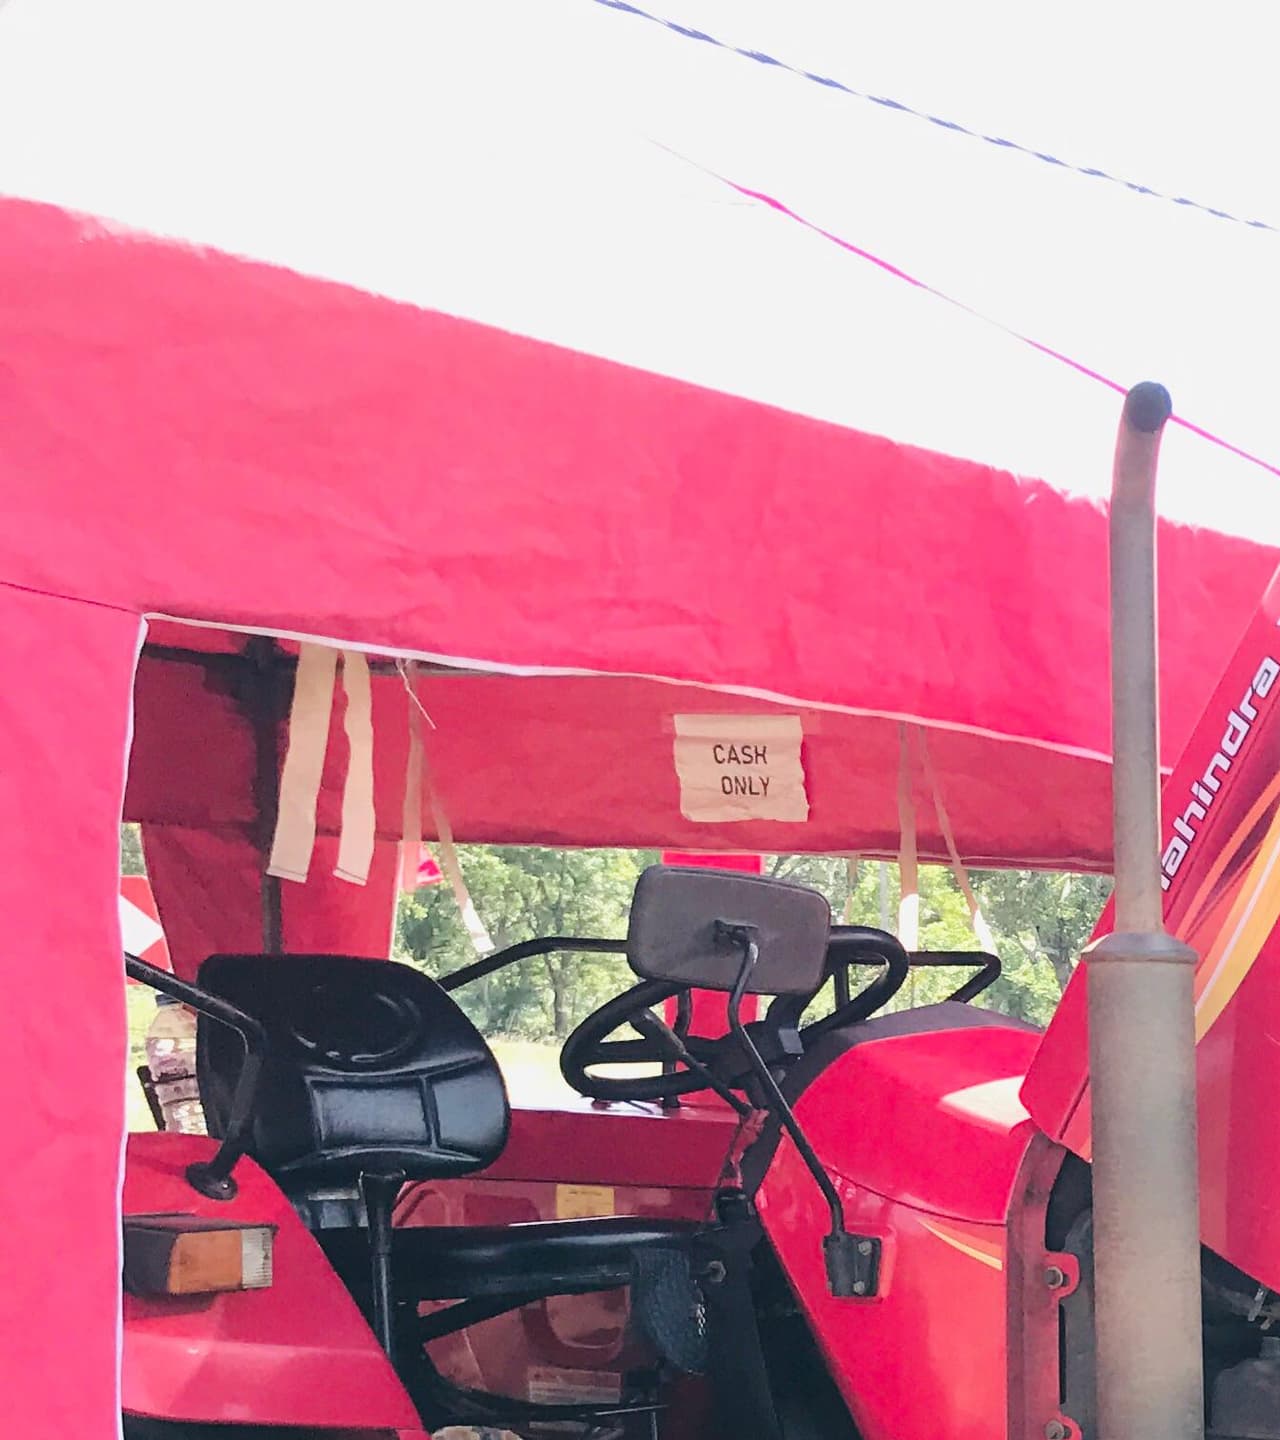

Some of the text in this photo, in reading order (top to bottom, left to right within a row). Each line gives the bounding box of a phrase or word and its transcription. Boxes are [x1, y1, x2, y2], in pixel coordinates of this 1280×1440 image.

[712, 744, 768, 765] CASH
[1161, 656, 1280, 892] ahindra
[721, 775, 770, 797] ONLY
